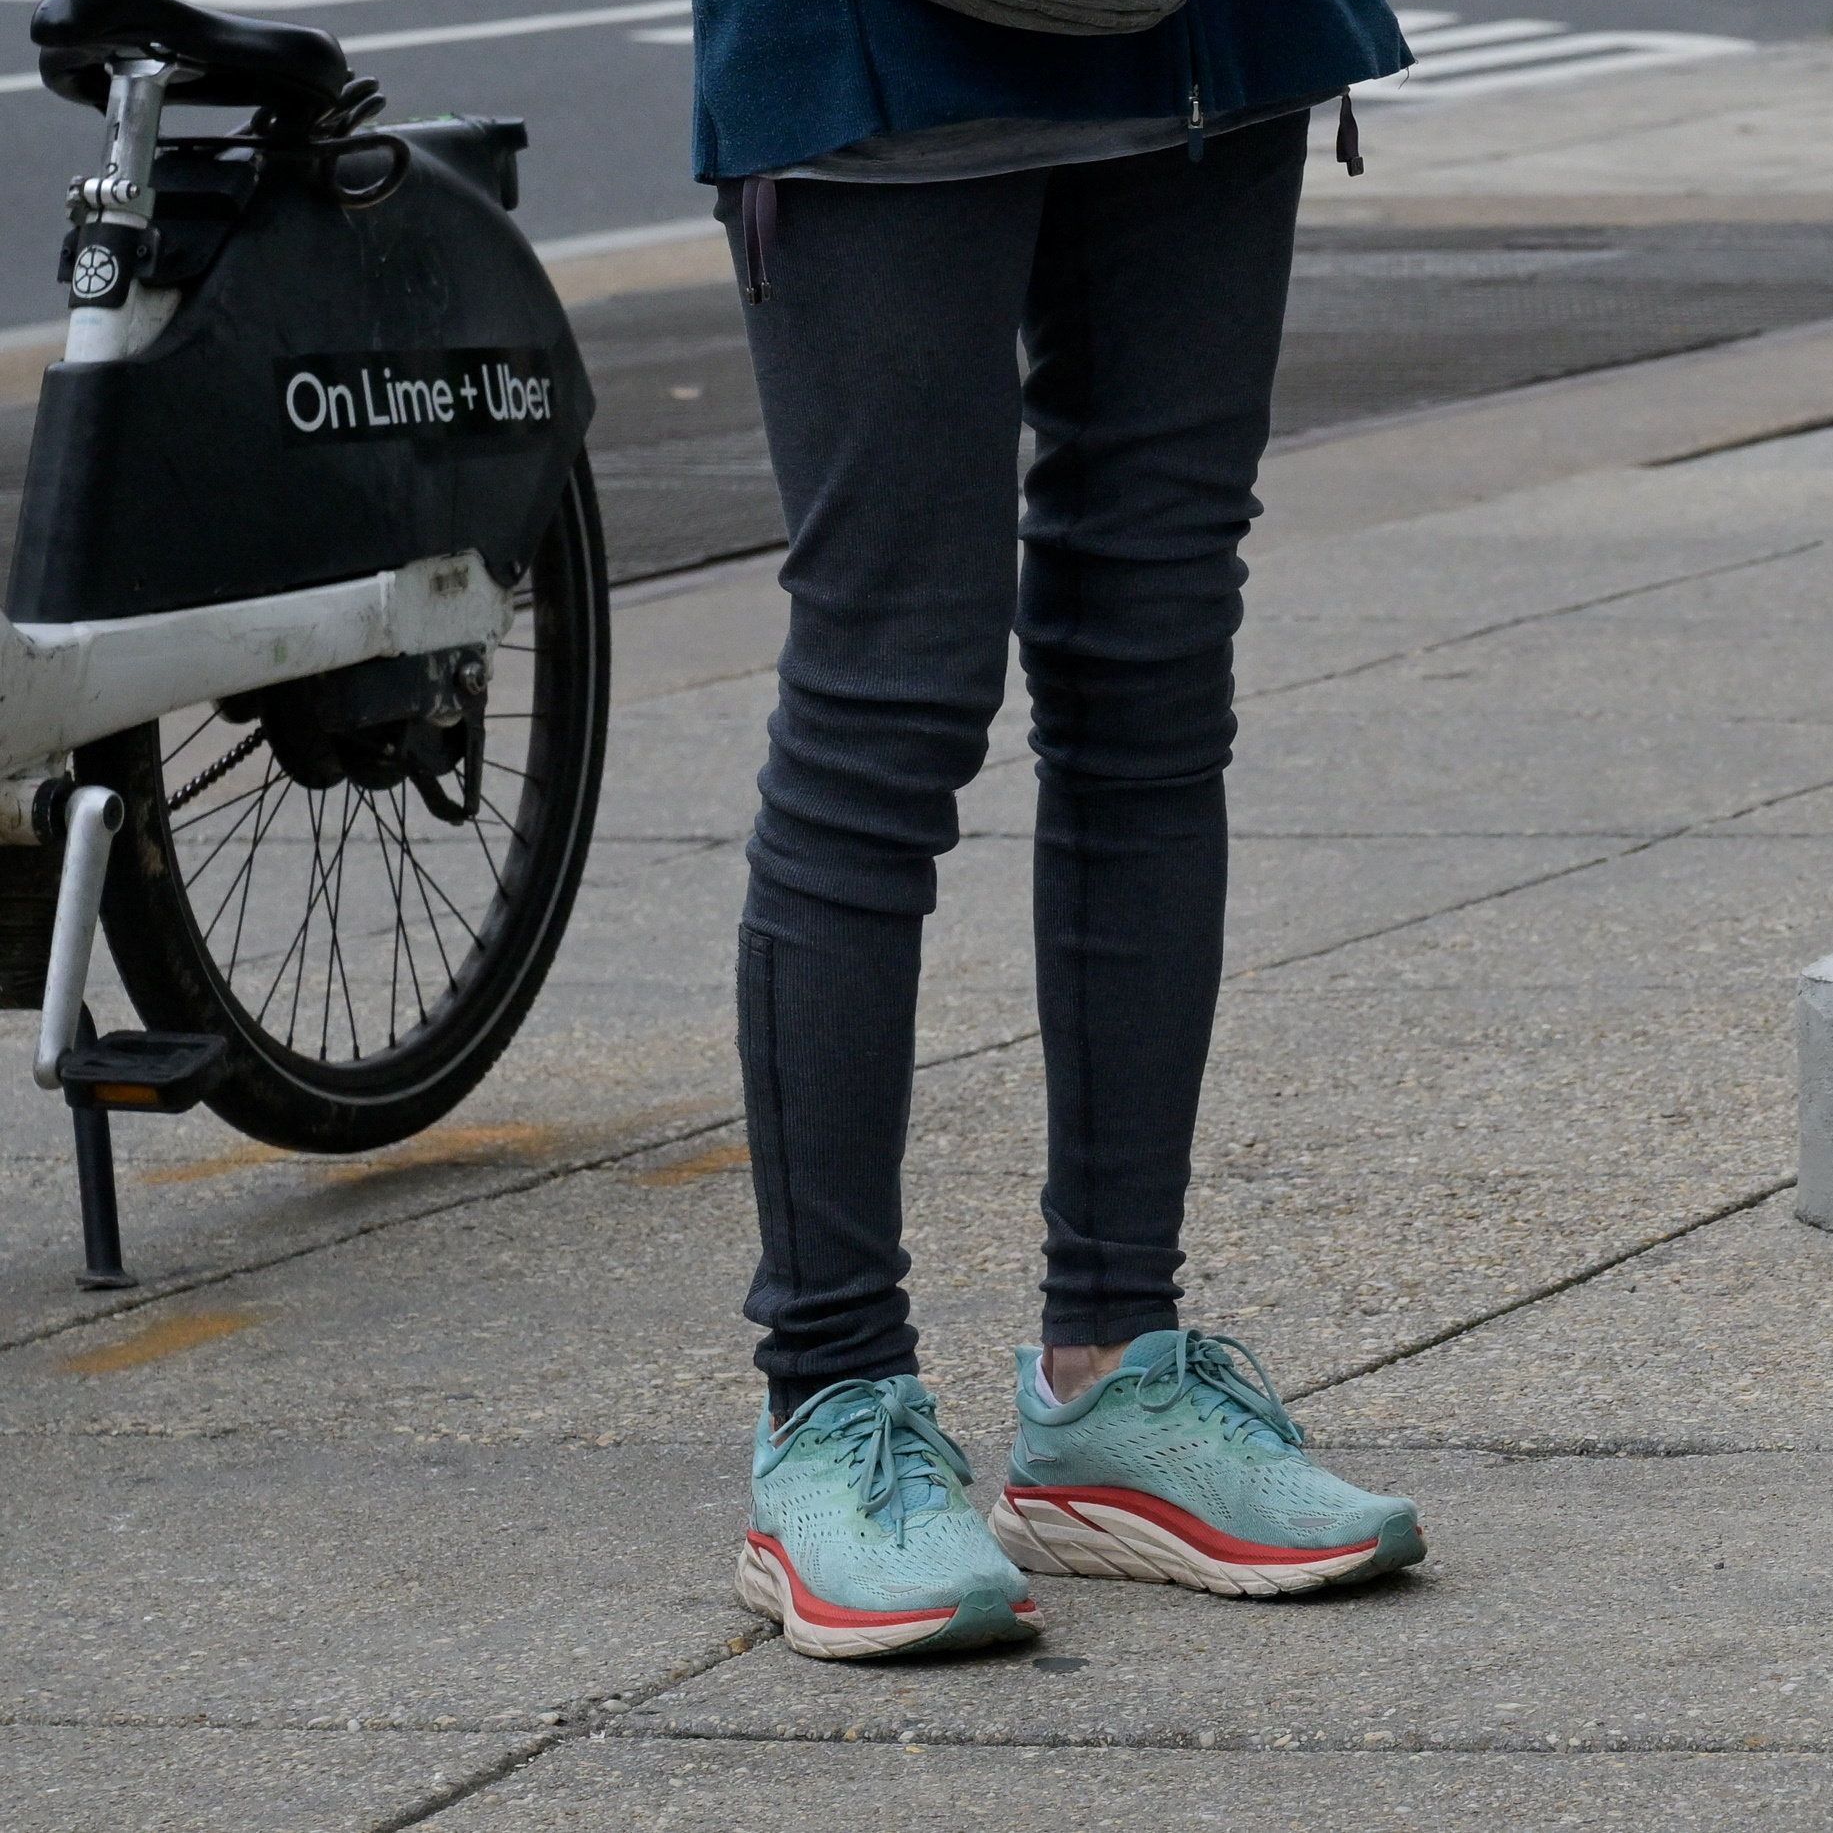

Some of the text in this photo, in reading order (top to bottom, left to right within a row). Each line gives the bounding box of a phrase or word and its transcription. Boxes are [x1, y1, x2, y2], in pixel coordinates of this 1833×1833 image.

[286, 363, 551, 433] On Lime + Uber
